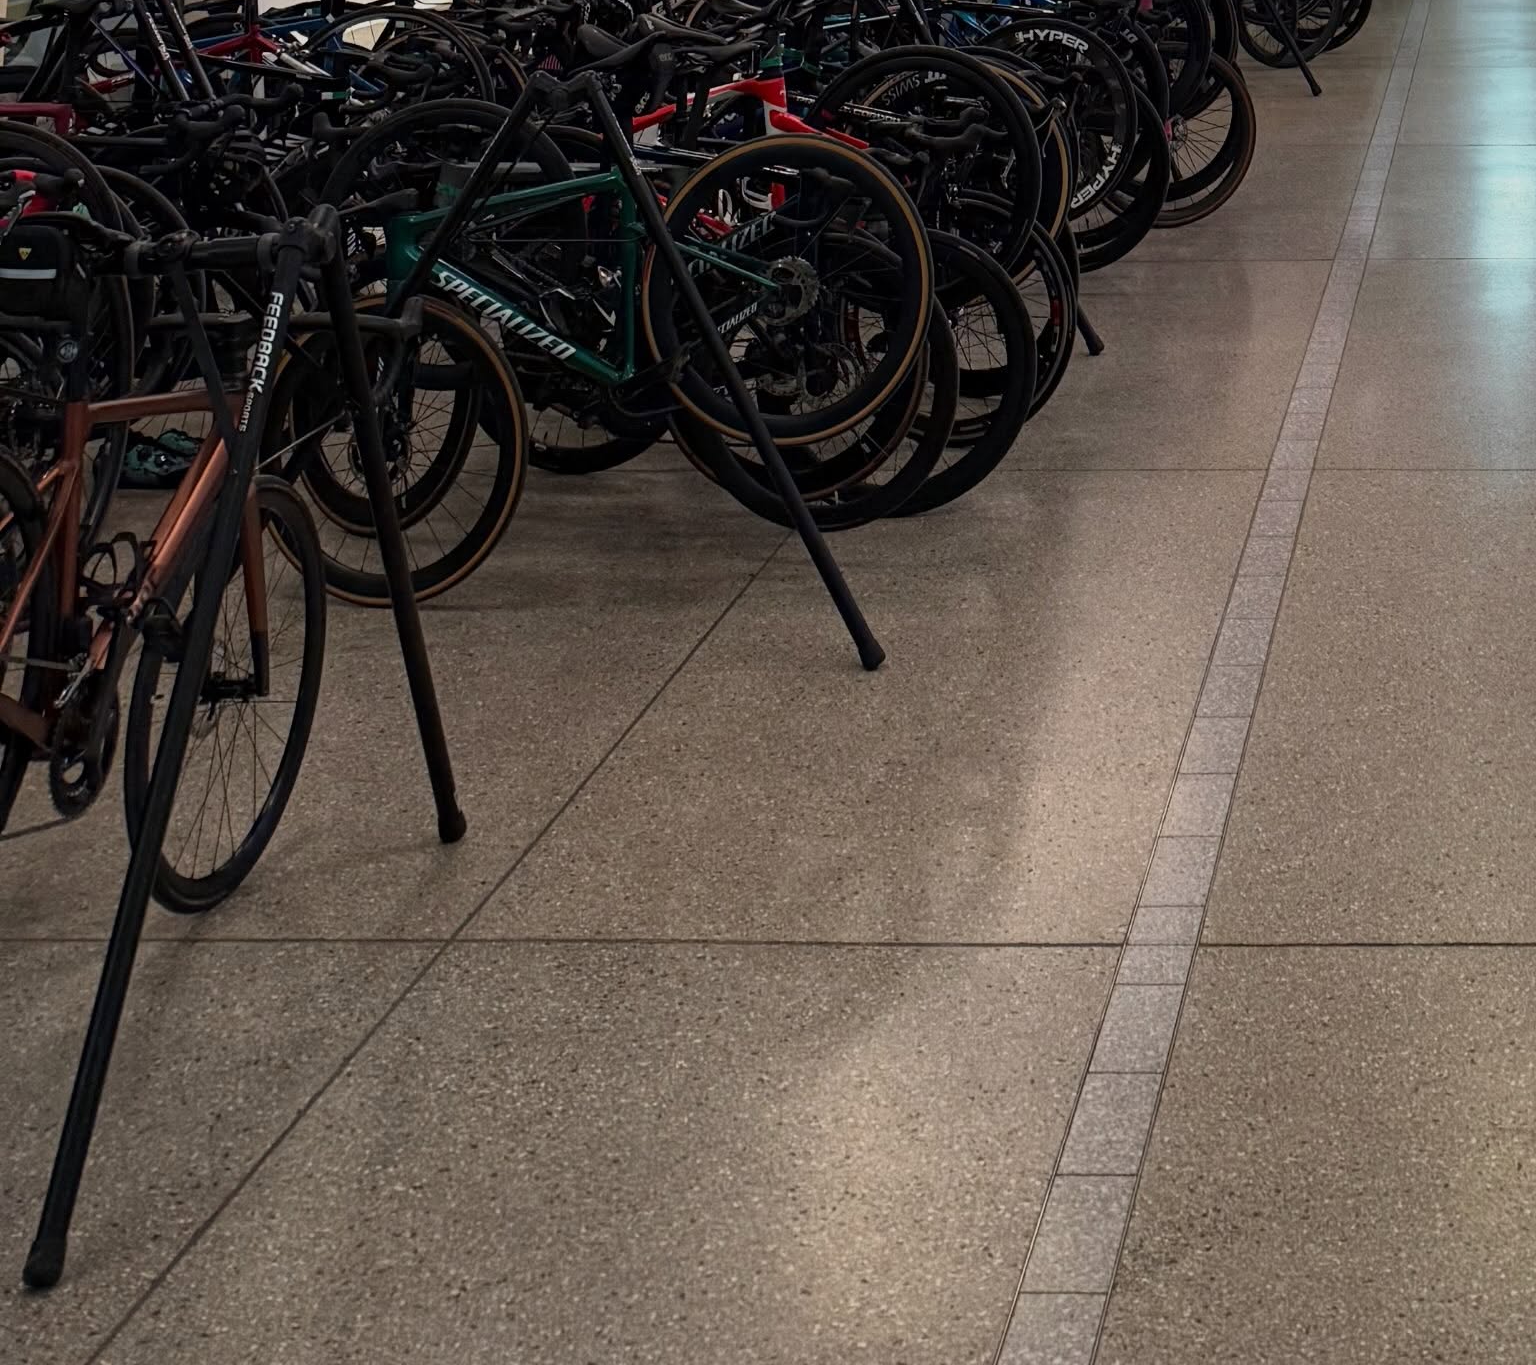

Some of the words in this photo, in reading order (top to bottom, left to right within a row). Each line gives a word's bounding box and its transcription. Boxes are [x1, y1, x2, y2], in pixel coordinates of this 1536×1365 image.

[1018, 28, 1089, 54] HYPER
[1070, 143, 1123, 209] HYPER
[248, 290, 285, 394] FEEDBACK
[432, 271, 577, 360] SPECIALIZED
[238, 390, 255, 433] SPORTS
